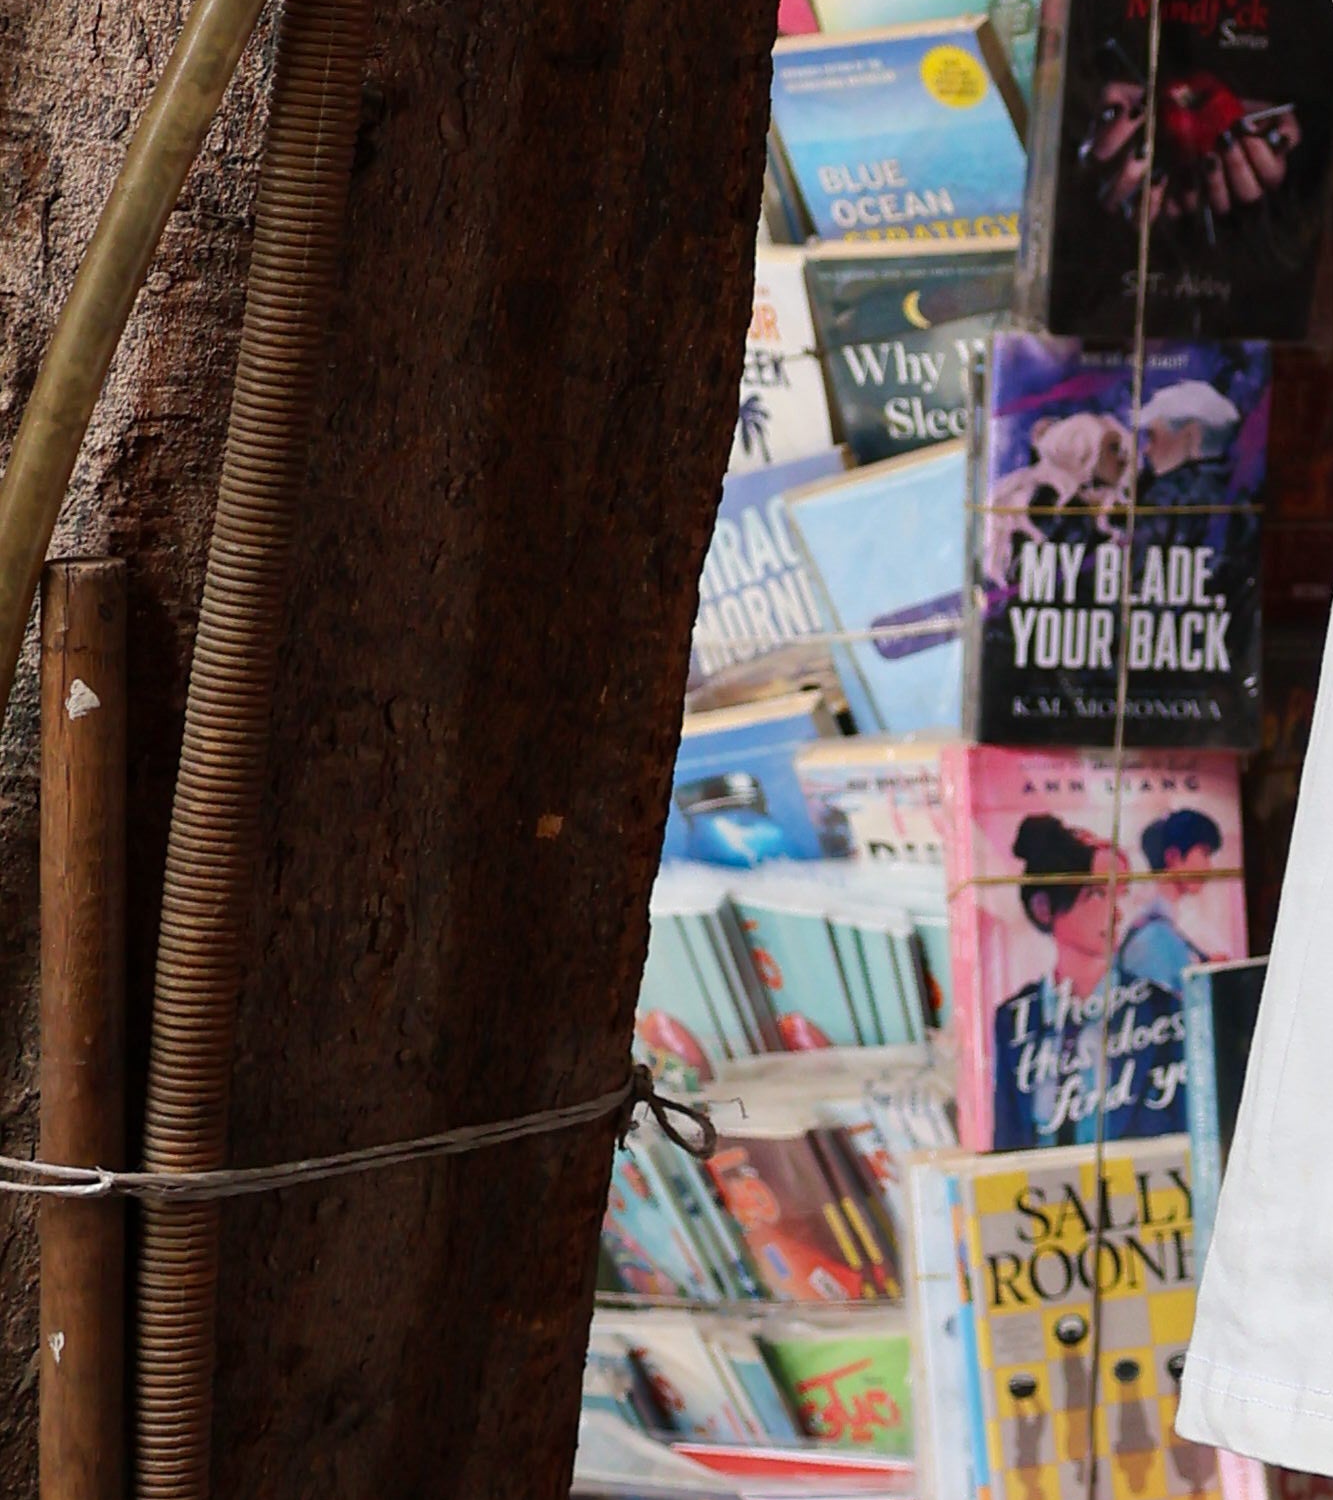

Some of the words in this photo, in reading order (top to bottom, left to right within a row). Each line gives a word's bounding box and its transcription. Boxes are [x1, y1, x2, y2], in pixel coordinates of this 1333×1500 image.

[817, 158, 907, 195] BLUE
[830, 186, 956, 229] OCEAN
[841, 340, 946, 394] Why
[1018, 540, 1087, 603] MY
[1009, 606, 1116, 670] YOUR
[1127, 609, 1232, 673] BACK
[1052, 976, 1154, 1033] hope
[1015, 1032, 1096, 1094] this
[1015, 1166, 1194, 1246] SALLY
[983, 1227, 1196, 1308] ROONE
